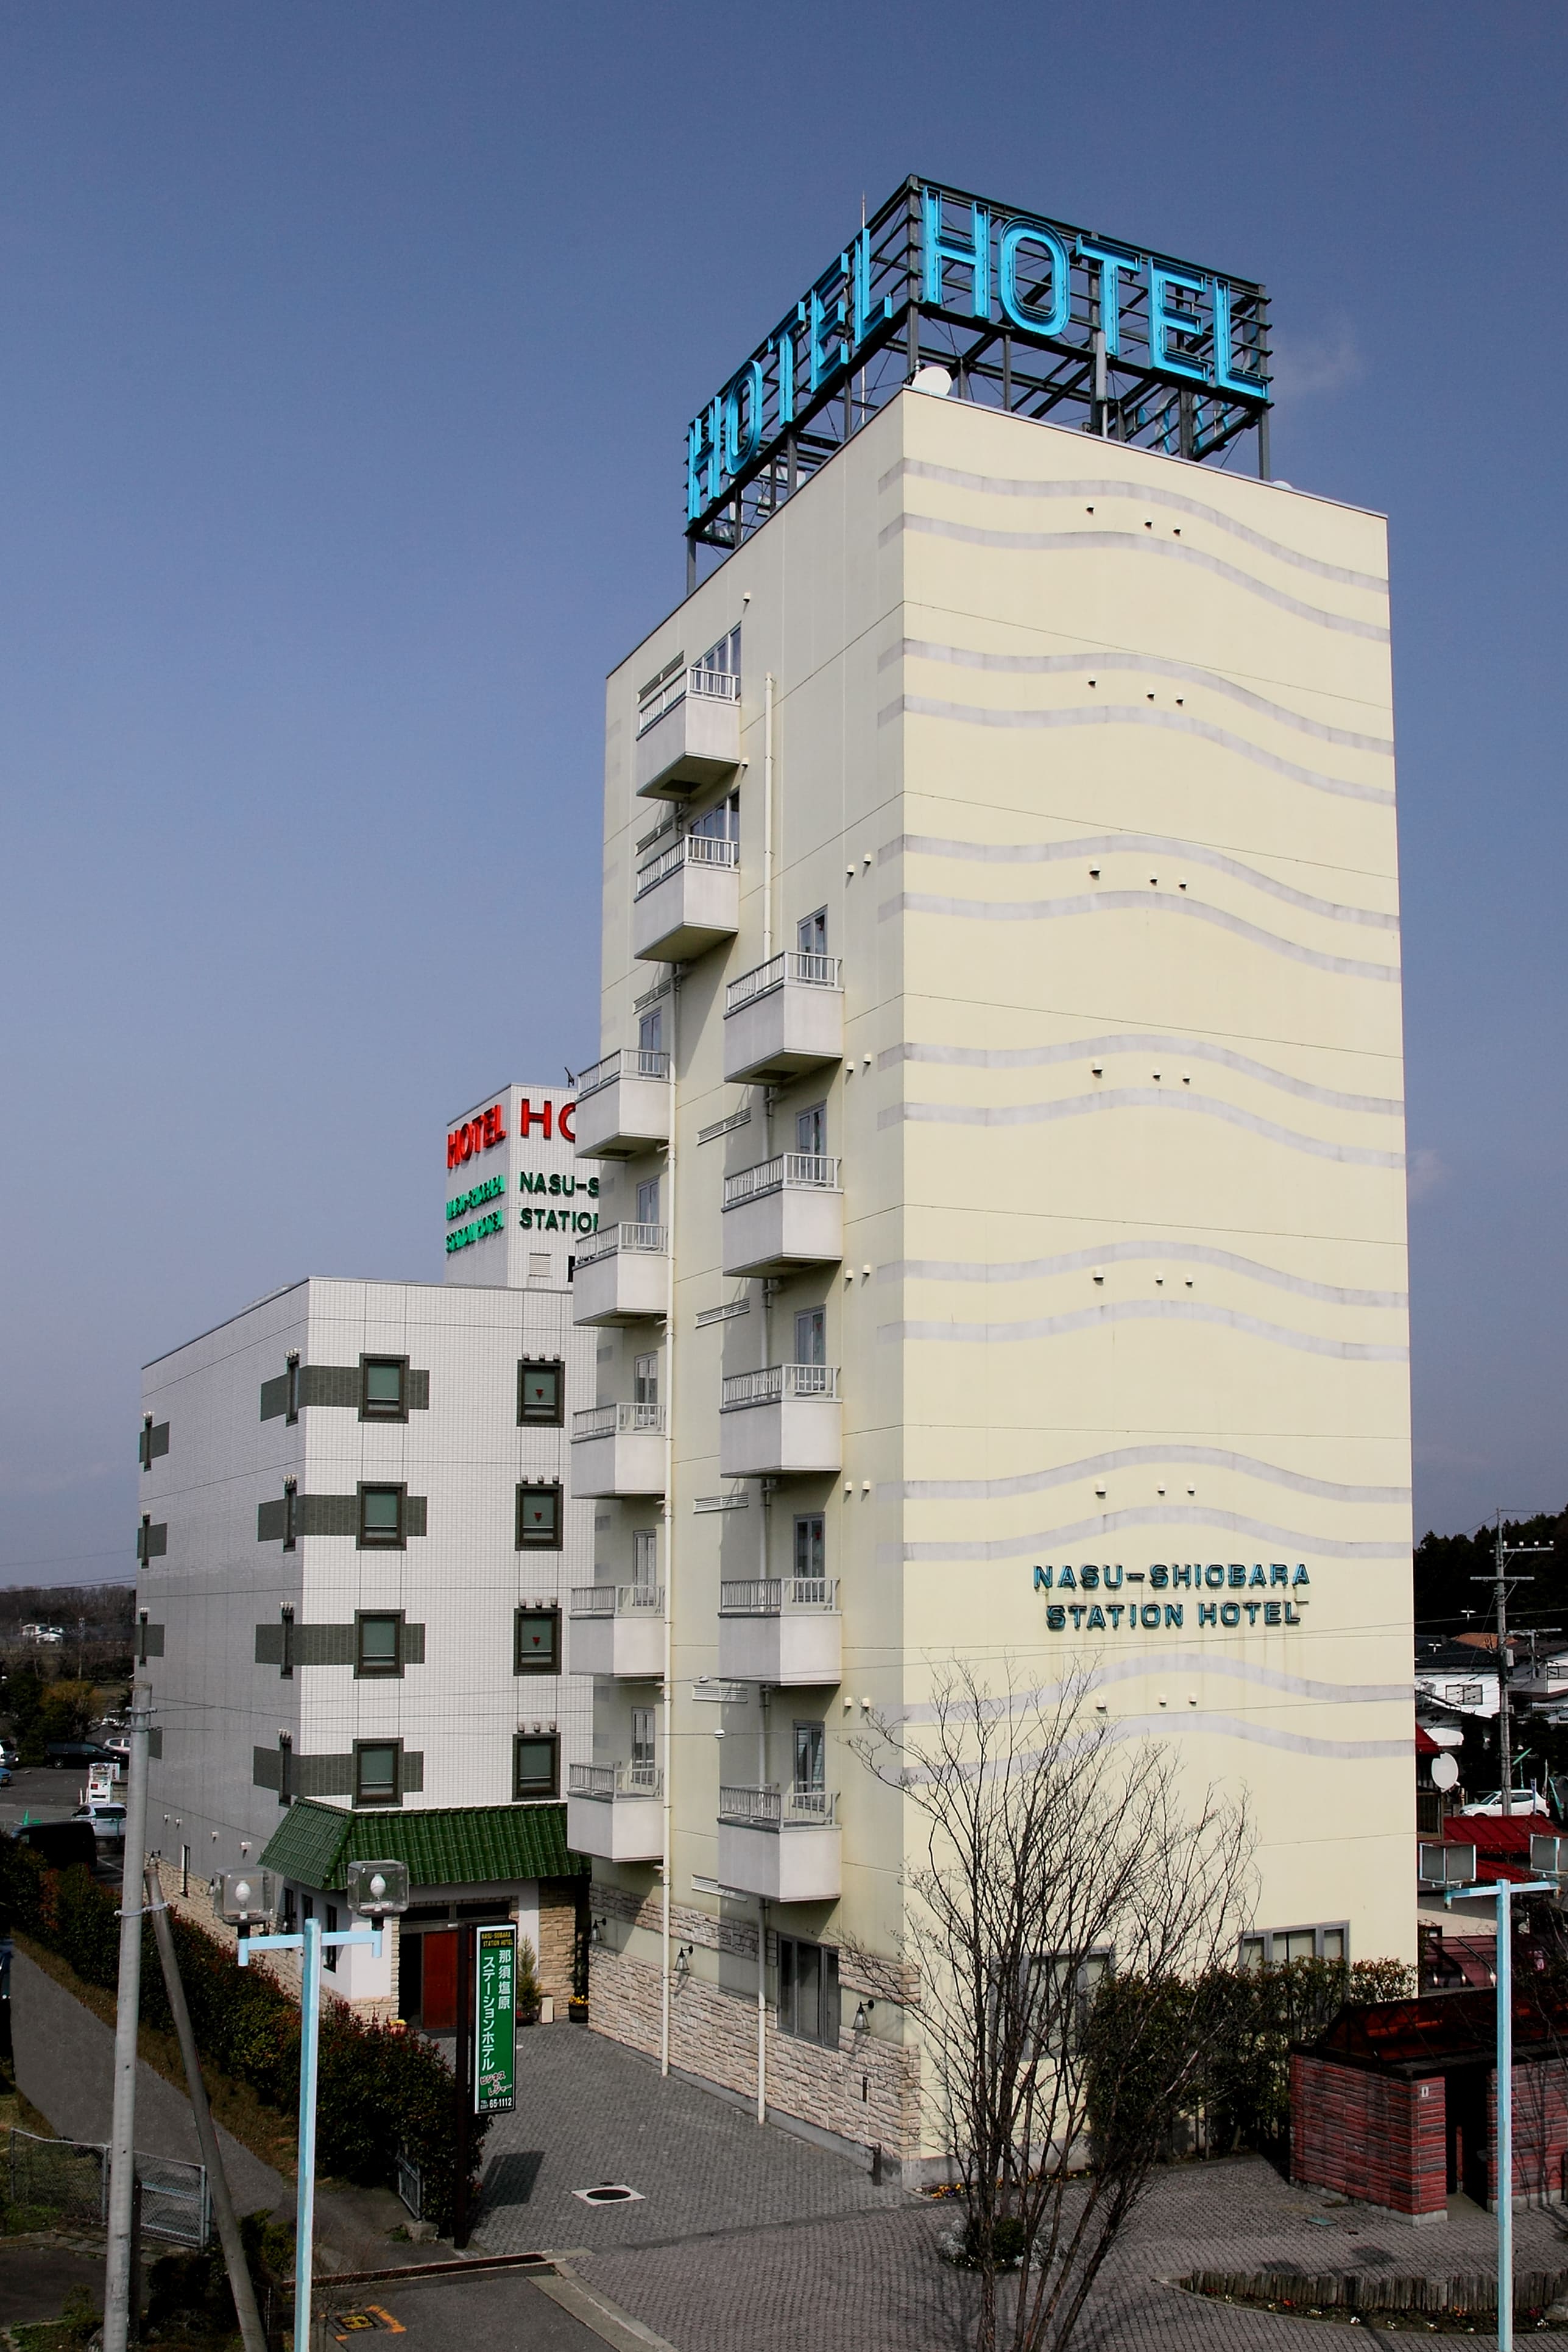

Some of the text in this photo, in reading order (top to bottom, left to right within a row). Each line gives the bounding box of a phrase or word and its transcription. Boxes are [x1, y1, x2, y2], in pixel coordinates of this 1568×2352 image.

[921, 185, 1269, 400] HOTEL
[688, 228, 893, 524] HOTEL
[447, 1104, 506, 1169] HOTEL
[1033, 1564, 1310, 1589] NASU-SHIOBARA
[1047, 1602, 1301, 1629] STATION HOTEL
[498, 1949, 512, 2010] 那須塩原
[482, 1956, 495, 2071] ステーションホテル
[489, 2097, 512, 2108] 65-1112
